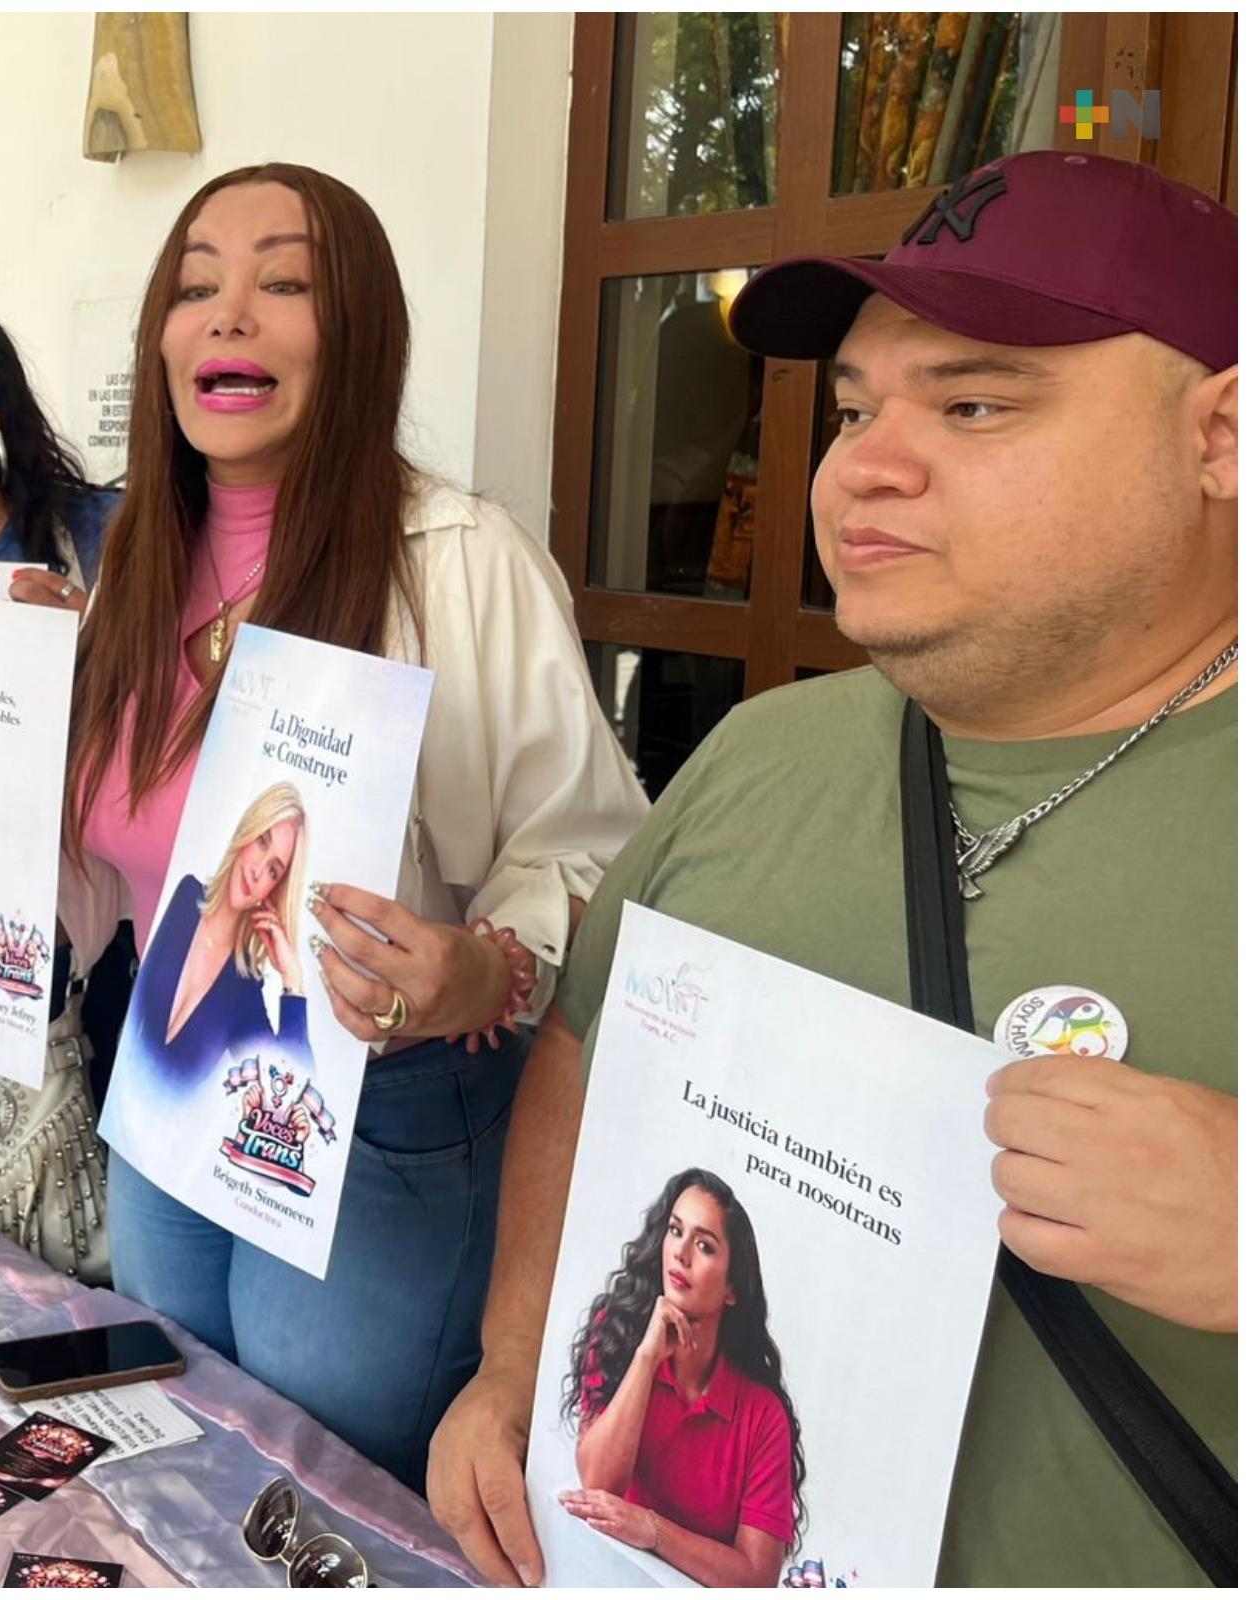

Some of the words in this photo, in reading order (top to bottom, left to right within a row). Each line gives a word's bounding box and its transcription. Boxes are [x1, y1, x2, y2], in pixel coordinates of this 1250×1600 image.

[902, 166, 1007, 247] NY
[98, 420, 130, 433] RESPON
[269, 708, 286, 735] La
[287, 713, 354, 758] Dignidad
[261, 741, 276, 758] se
[276, 740, 349, 788] Construye
[1016, 996, 1045, 1023] SOY
[1011, 1025, 1036, 1057] HUM
[239, 1119, 303, 1170] Trans
[252, 1108, 297, 1145] Voces
[682, 1079, 707, 1110] La
[707, 1095, 779, 1147] justicia
[784, 1134, 873, 1194] también
[878, 1184, 903, 1208] es
[213, 1165, 253, 1198] Brigeth
[745, 1153, 792, 1189] para
[797, 1177, 902, 1246] nosotrans
